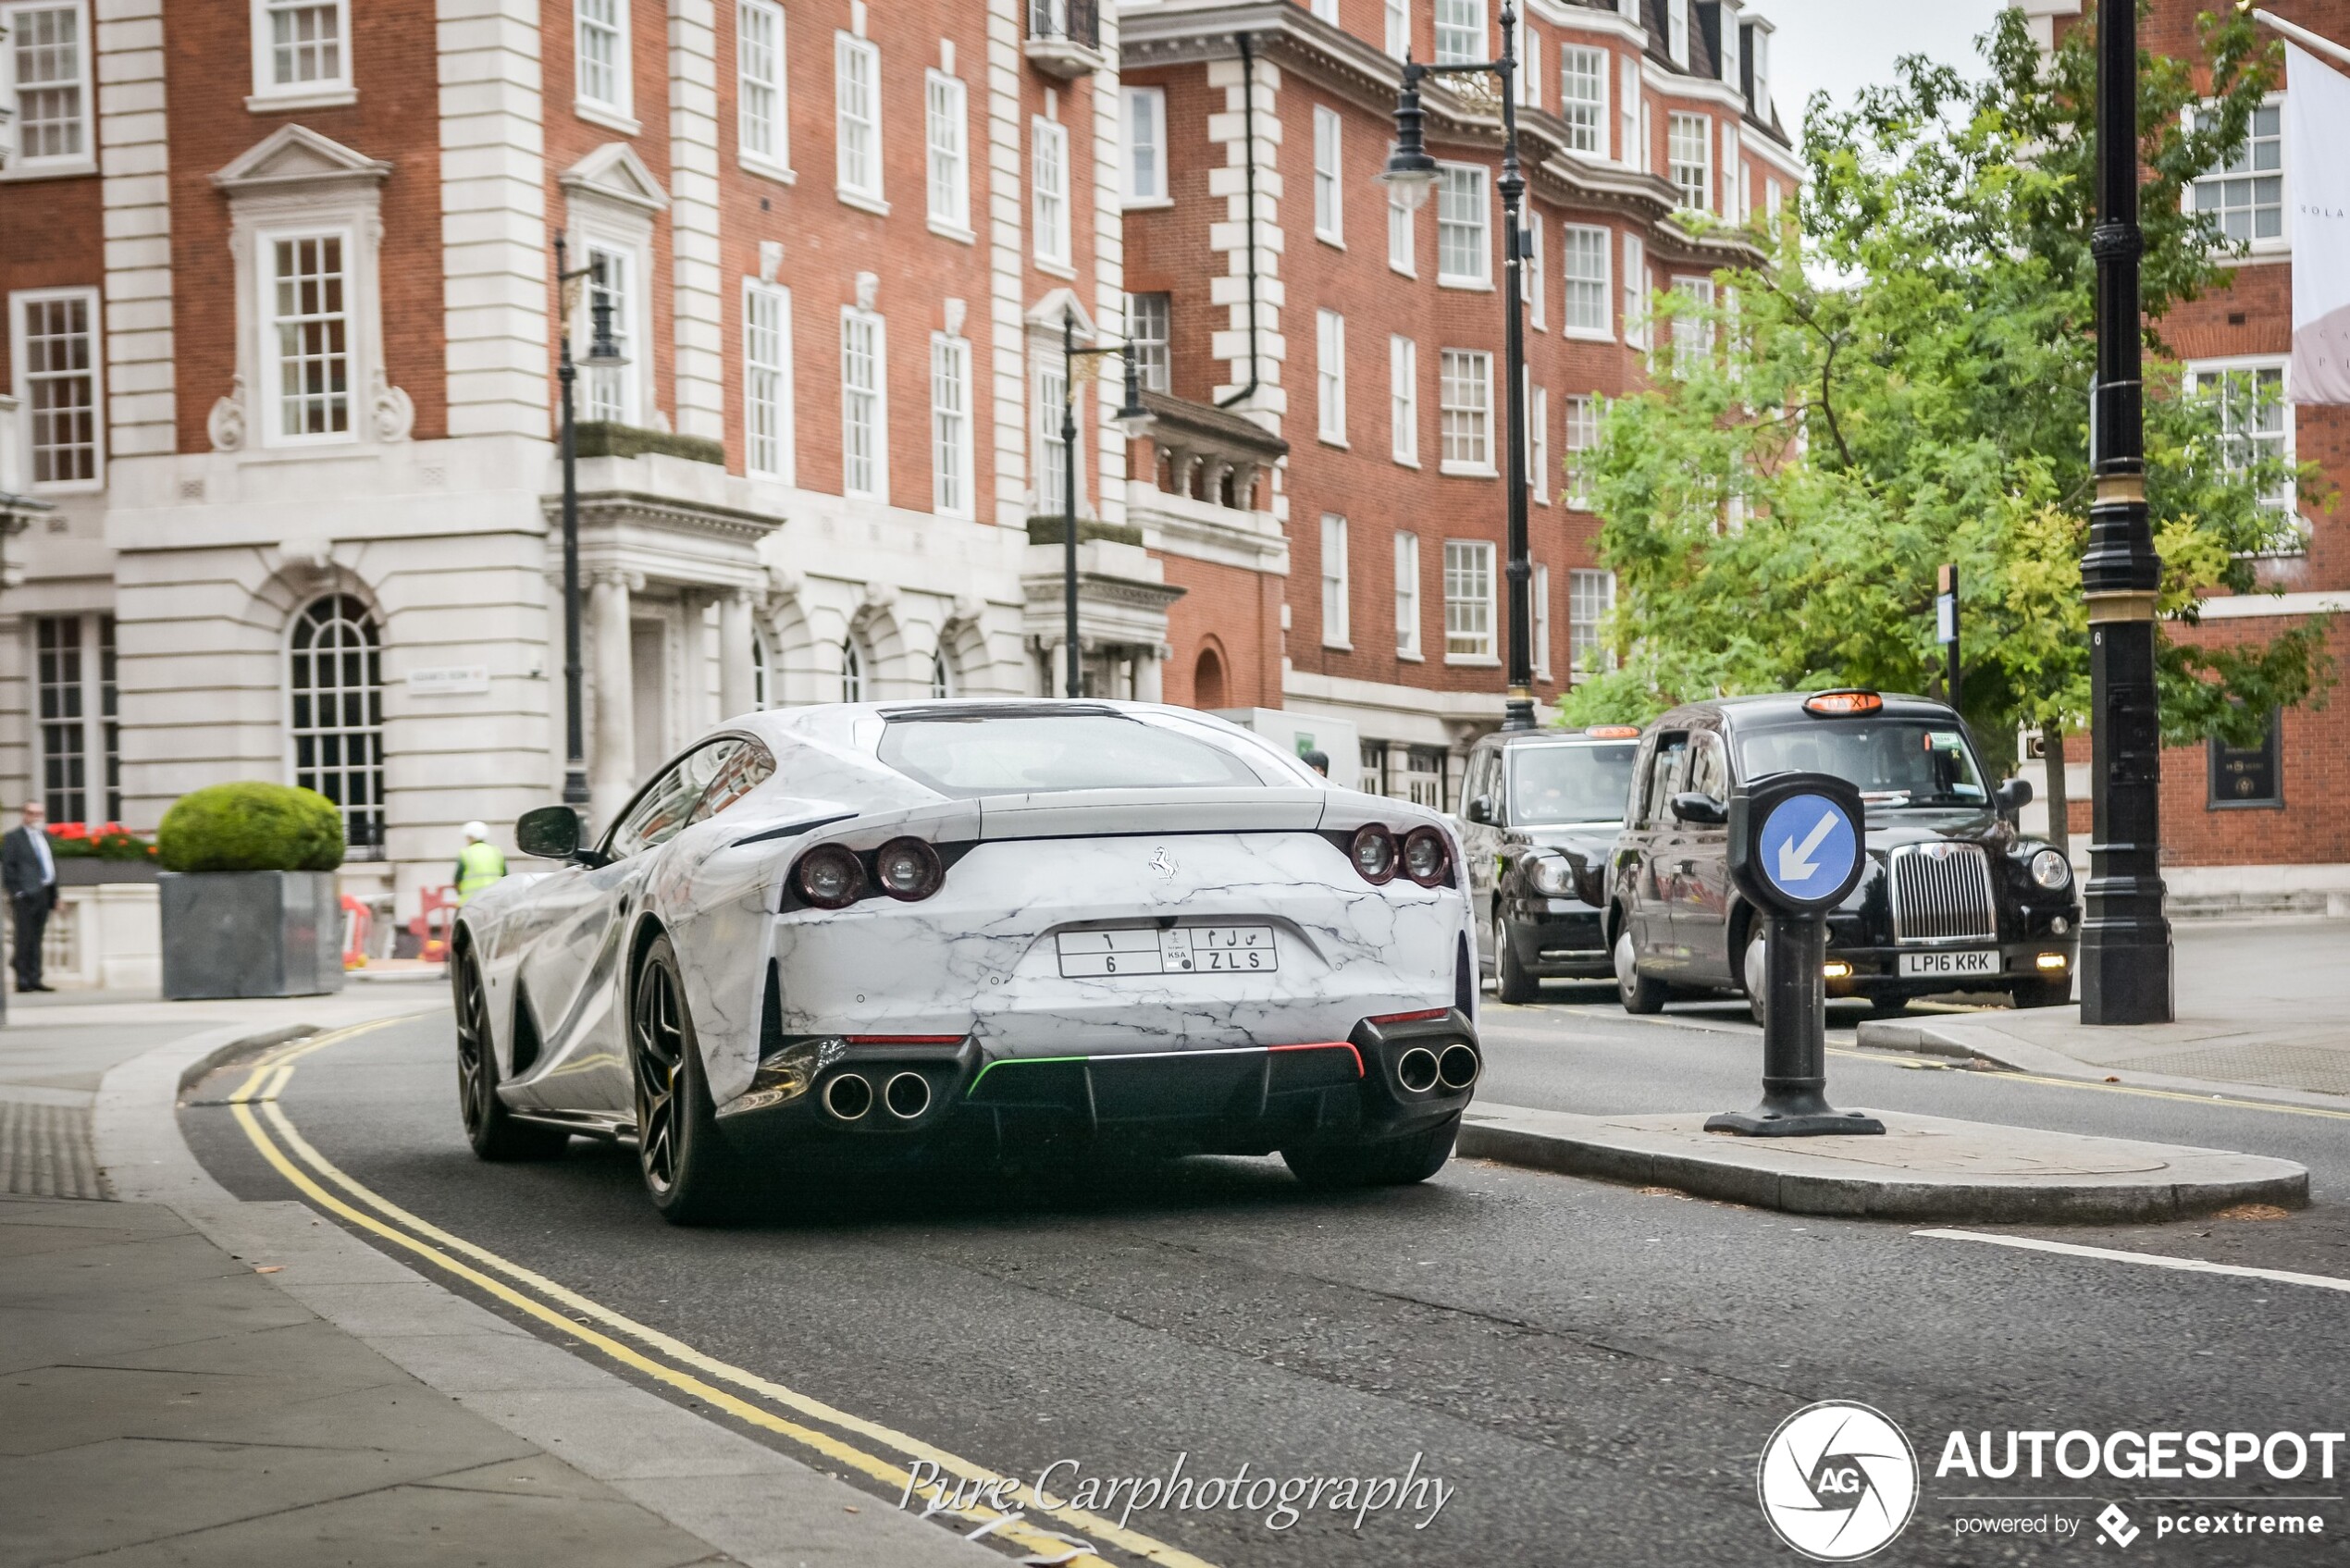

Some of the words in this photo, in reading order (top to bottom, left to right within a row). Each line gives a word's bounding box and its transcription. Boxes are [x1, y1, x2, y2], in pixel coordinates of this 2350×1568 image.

[2095, 632, 2101, 645] 6
[1824, 696, 1870, 709] TAXI
[1106, 956, 1116, 972] 6
[1911, 955, 1950, 972] LP16
[1956, 953, 1989, 970] KRK
